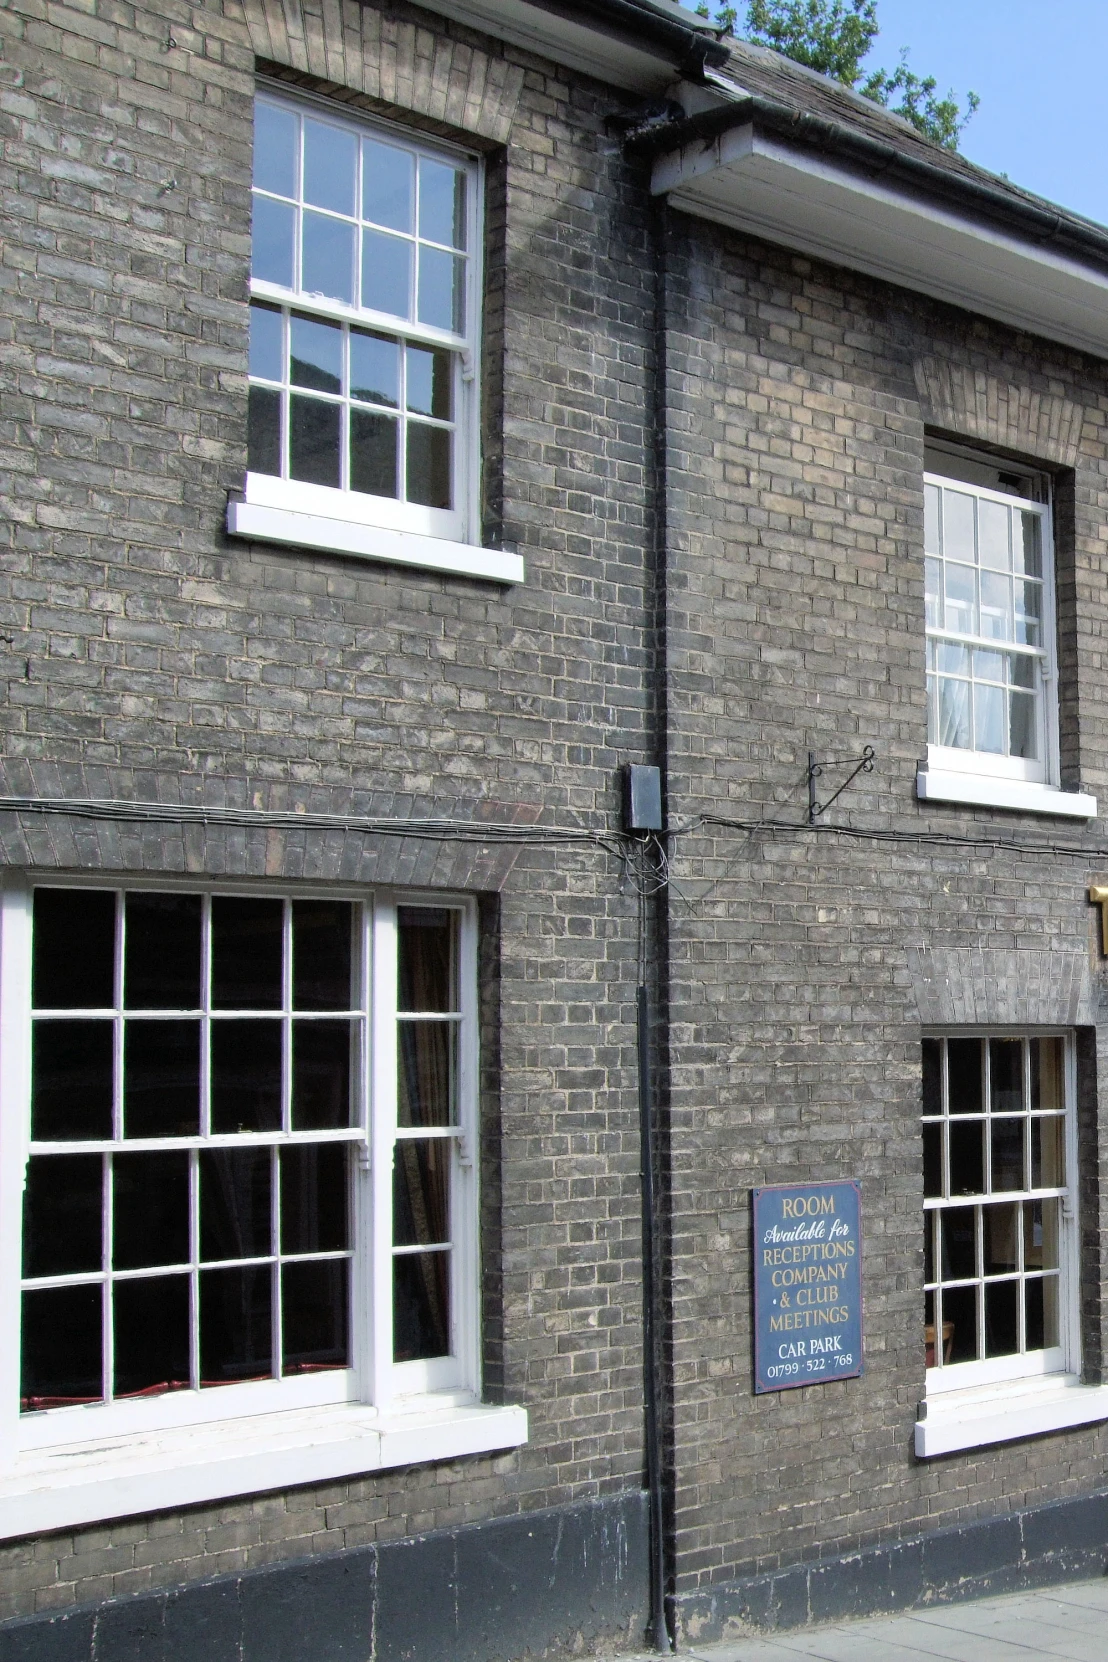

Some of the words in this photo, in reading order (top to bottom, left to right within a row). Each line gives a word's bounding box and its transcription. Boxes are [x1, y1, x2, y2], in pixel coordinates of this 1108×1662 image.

[782, 1195, 834, 1219] ROOM
[764, 1220, 825, 1243] Available
[829, 1219, 849, 1240] for
[764, 1241, 855, 1266] RECEPTIONS
[772, 1263, 848, 1287] COMPANY
[780, 1292, 790, 1308] &
[797, 1286, 838, 1306] CLUB
[769, 1306, 849, 1332] MEETINGS
[779, 1342, 806, 1359] CAR
[810, 1336, 842, 1355] PARK
[767, 1362, 799, 1378] 01799
[807, 1358, 825, 1371] 522
[834, 1354, 852, 1368] 768
